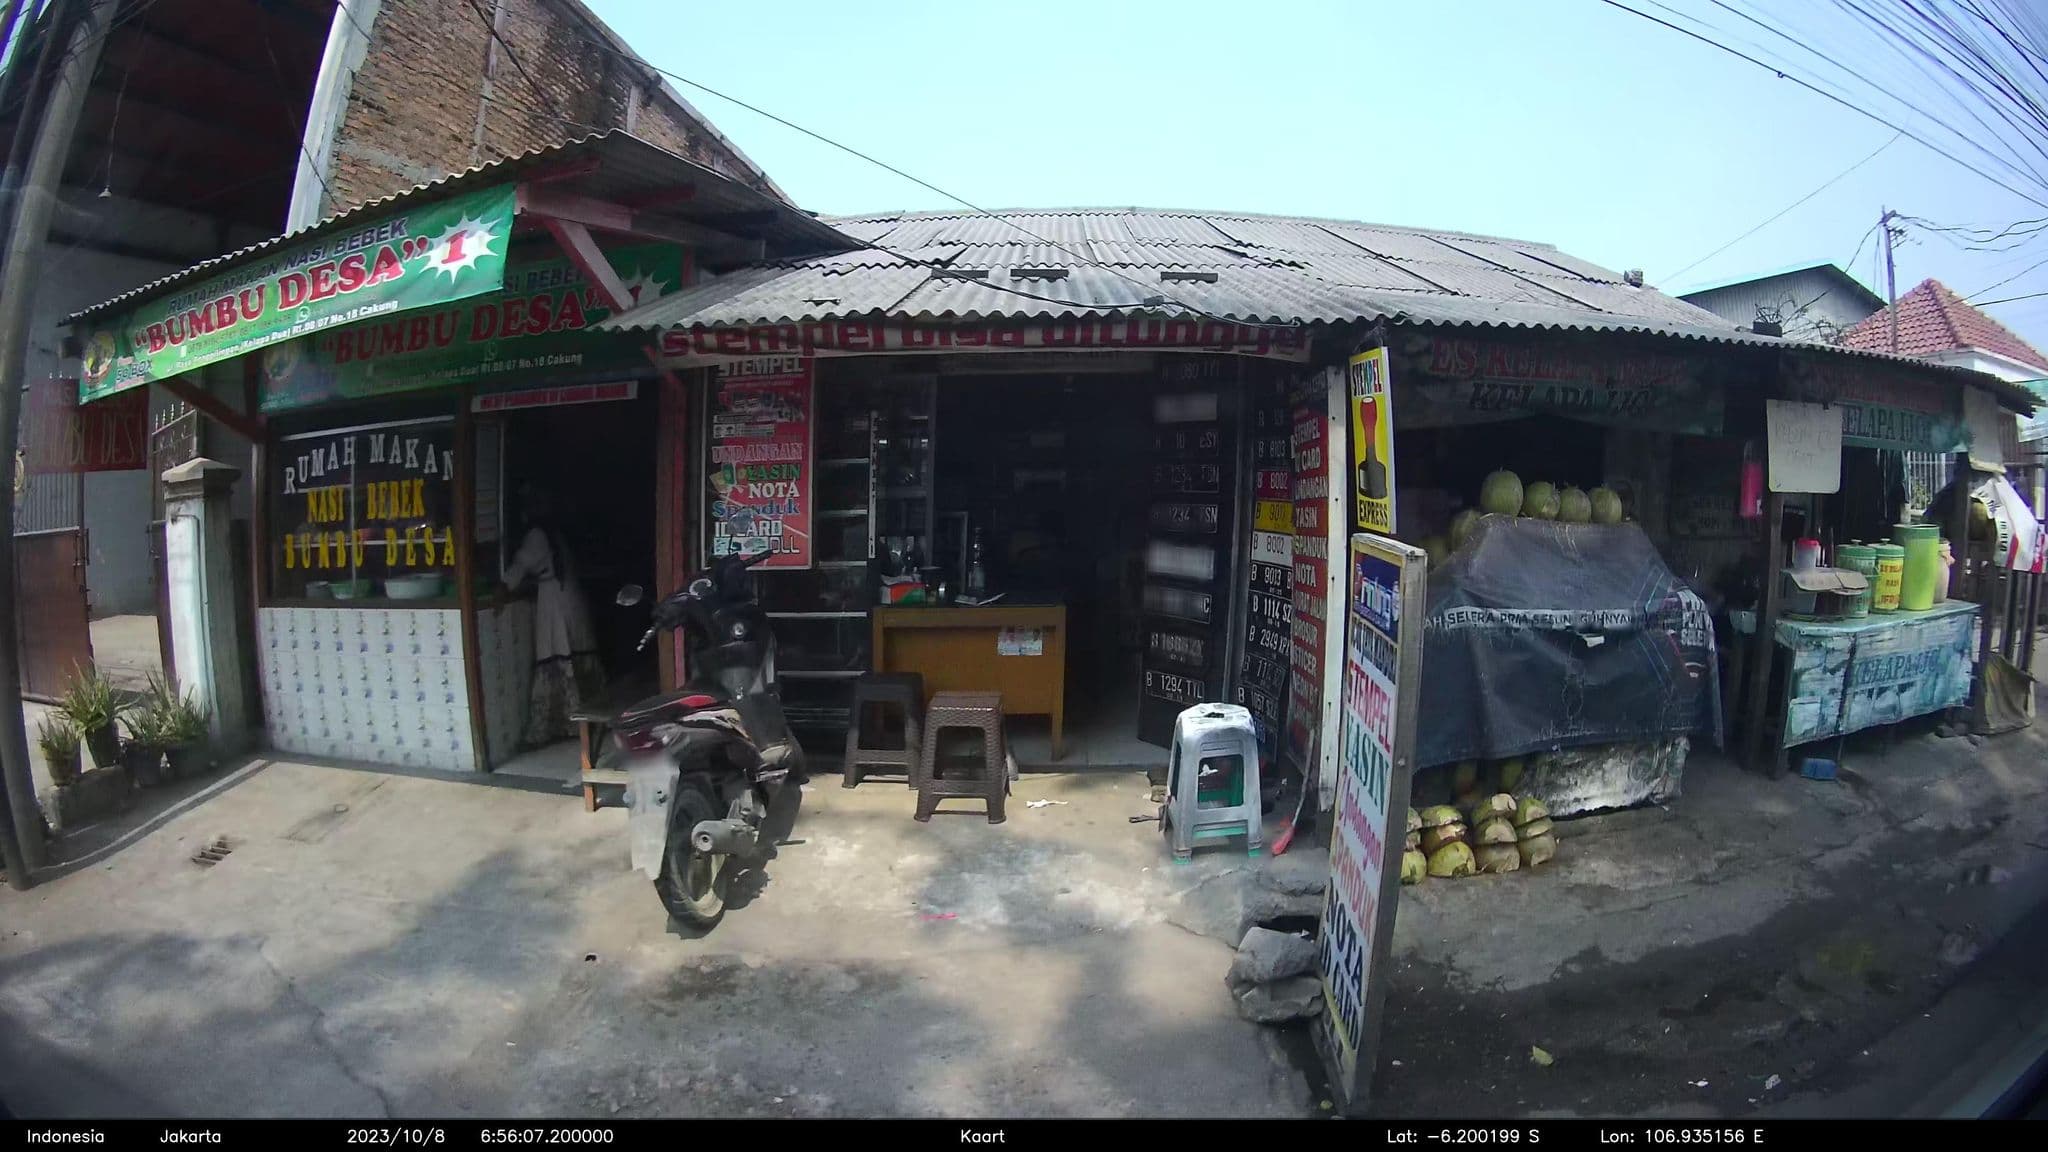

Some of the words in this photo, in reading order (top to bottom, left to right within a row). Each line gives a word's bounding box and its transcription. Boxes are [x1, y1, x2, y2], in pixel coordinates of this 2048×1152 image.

[284, 246, 326, 271] NASI
[335, 215, 410, 256] BEBEK
[439, 229, 469, 265] 1
[359, 299, 399, 317] Cakung
[547, 352, 583, 367] Cakung
[1842, 405, 1896, 440] ELAPA
[284, 436, 357, 495] RUMAH
[369, 433, 454, 481] MAKAN
[711, 443, 803, 464] UNDANGAN
[307, 484, 345, 523] NASI
[367, 478, 426, 520] BEBEK
[748, 480, 800, 498] NOTA
[1295, 506, 1318, 529] YASIN
[1359, 499, 1388, 528] EXPRESS
[285, 529, 364, 569] BUMBU
[384, 526, 456, 567] DESA
[1295, 563, 1317, 588] NOTA
[1446, 610, 1495, 626] SELERA
[1146, 671, 1153, 688] B
[1160, 674, 1183, 694] 1294
[1237, 686, 1244, 704] B
[1347, 661, 1391, 754] STEMPEL
[1344, 708, 1390, 816] YASIN
[1326, 876, 1363, 1008] NOTA
[1332, 958, 1359, 1052] CARD
